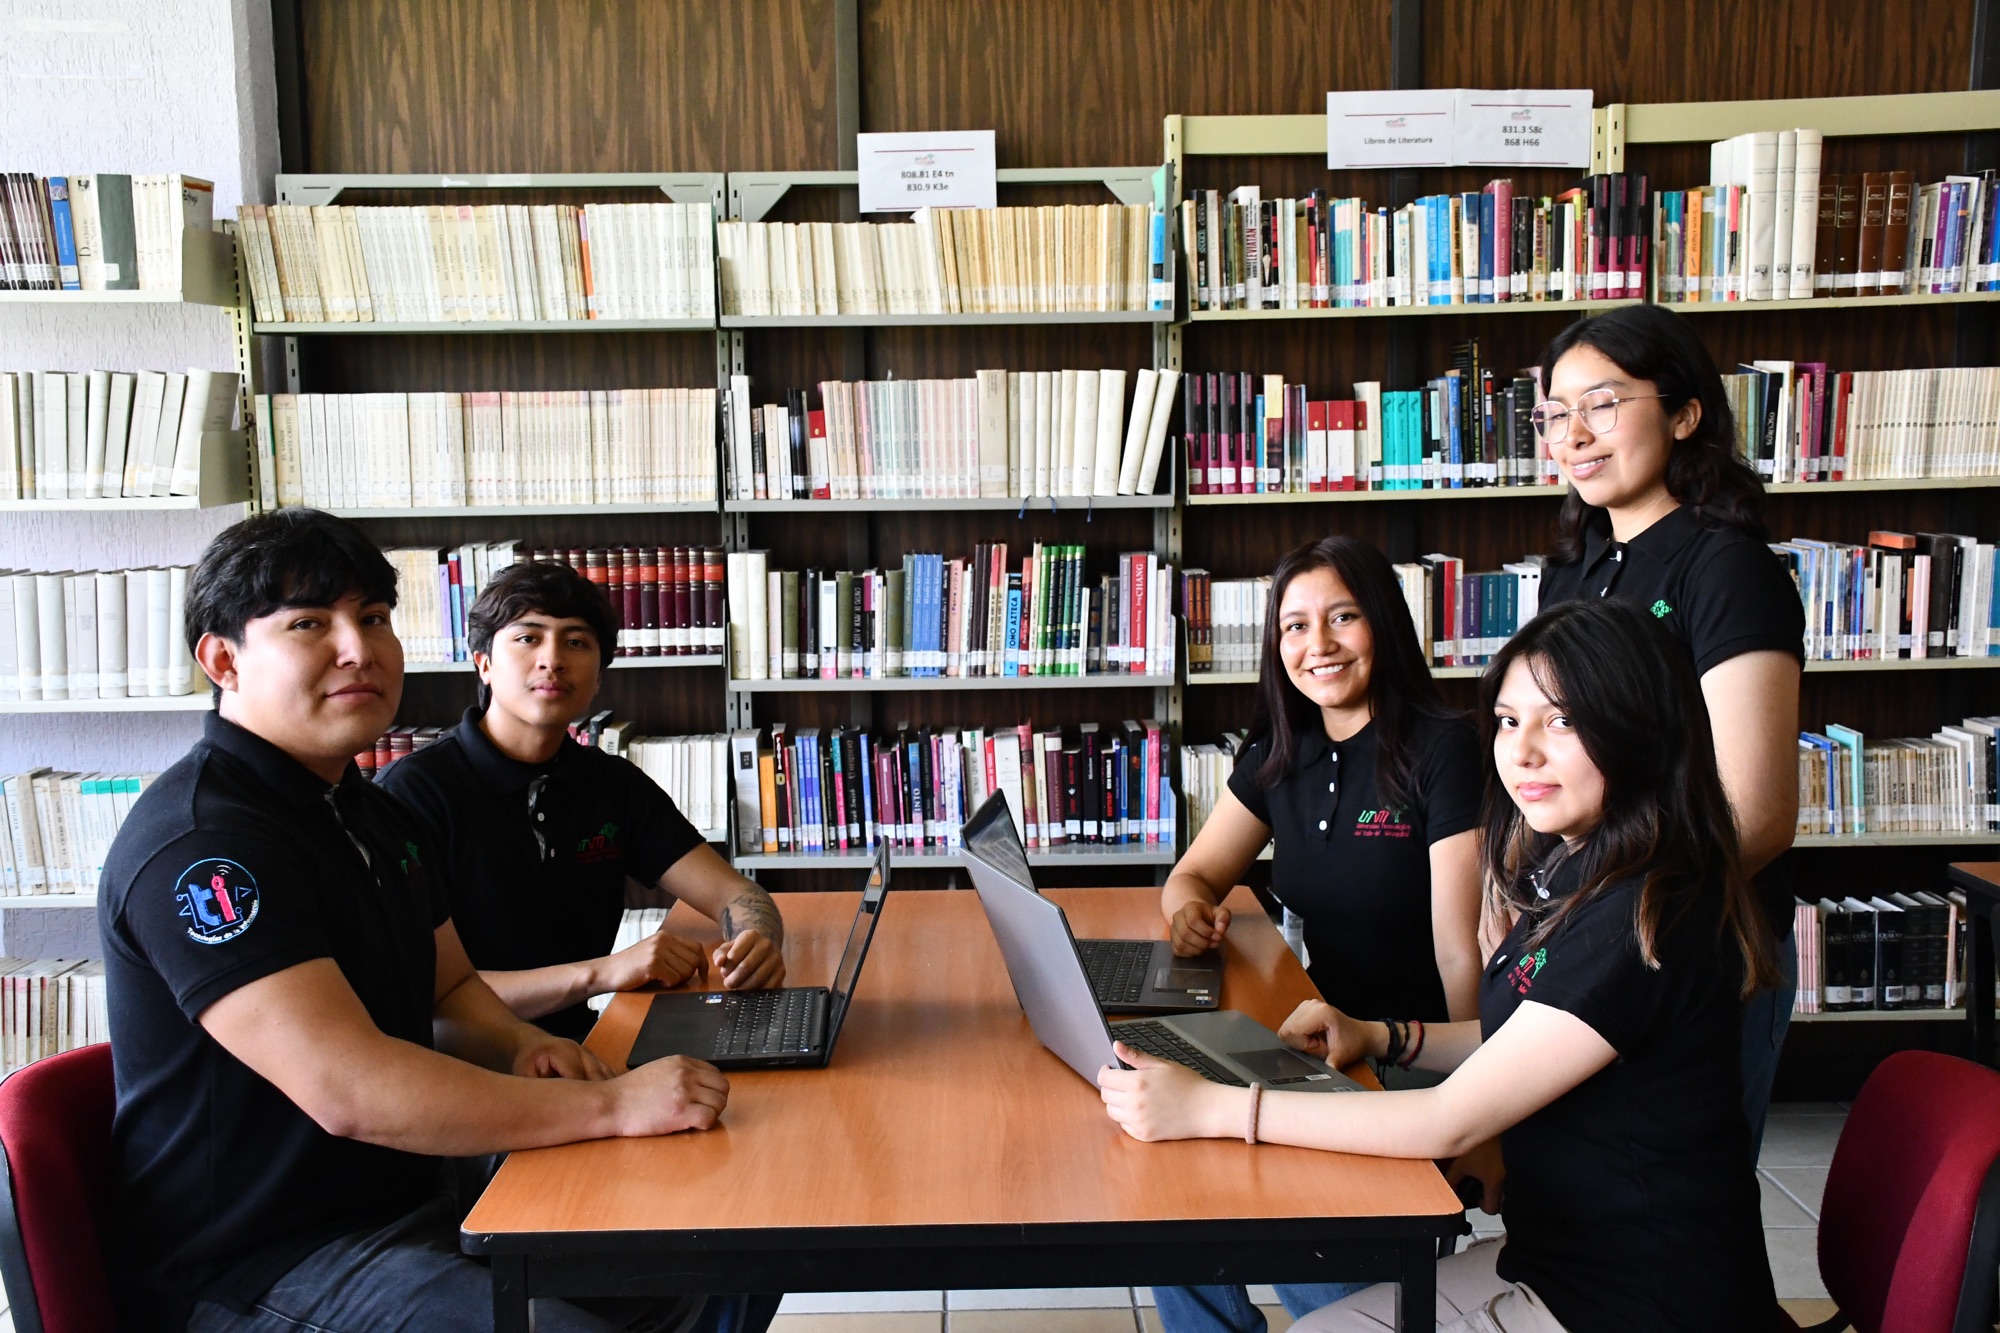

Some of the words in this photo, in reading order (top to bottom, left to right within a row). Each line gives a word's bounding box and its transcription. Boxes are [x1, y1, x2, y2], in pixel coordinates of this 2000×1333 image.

[1502, 126, 1526, 134] 831.3
[1528, 126, 1543, 134] S8c
[1364, 136, 1386, 144] Libros
[1388, 136, 1396, 144] de
[1398, 136, 1433, 144] Literatura
[1504, 138, 1520, 146] 868
[1522, 138, 1540, 146] H66
[901, 170, 929, 179] 808.81
[932, 170, 942, 178] E4
[906, 184, 930, 192] 830.9
[933, 182, 949, 190] K3e
[1535, 212, 1543, 258] ARMAGEDO
[1765, 412, 1775, 446] OSCUROS
[1010, 597, 1018, 625] AZTECA
[11, 801, 19, 829] WERTHER
[16, 838, 24, 861] FAUSTO
